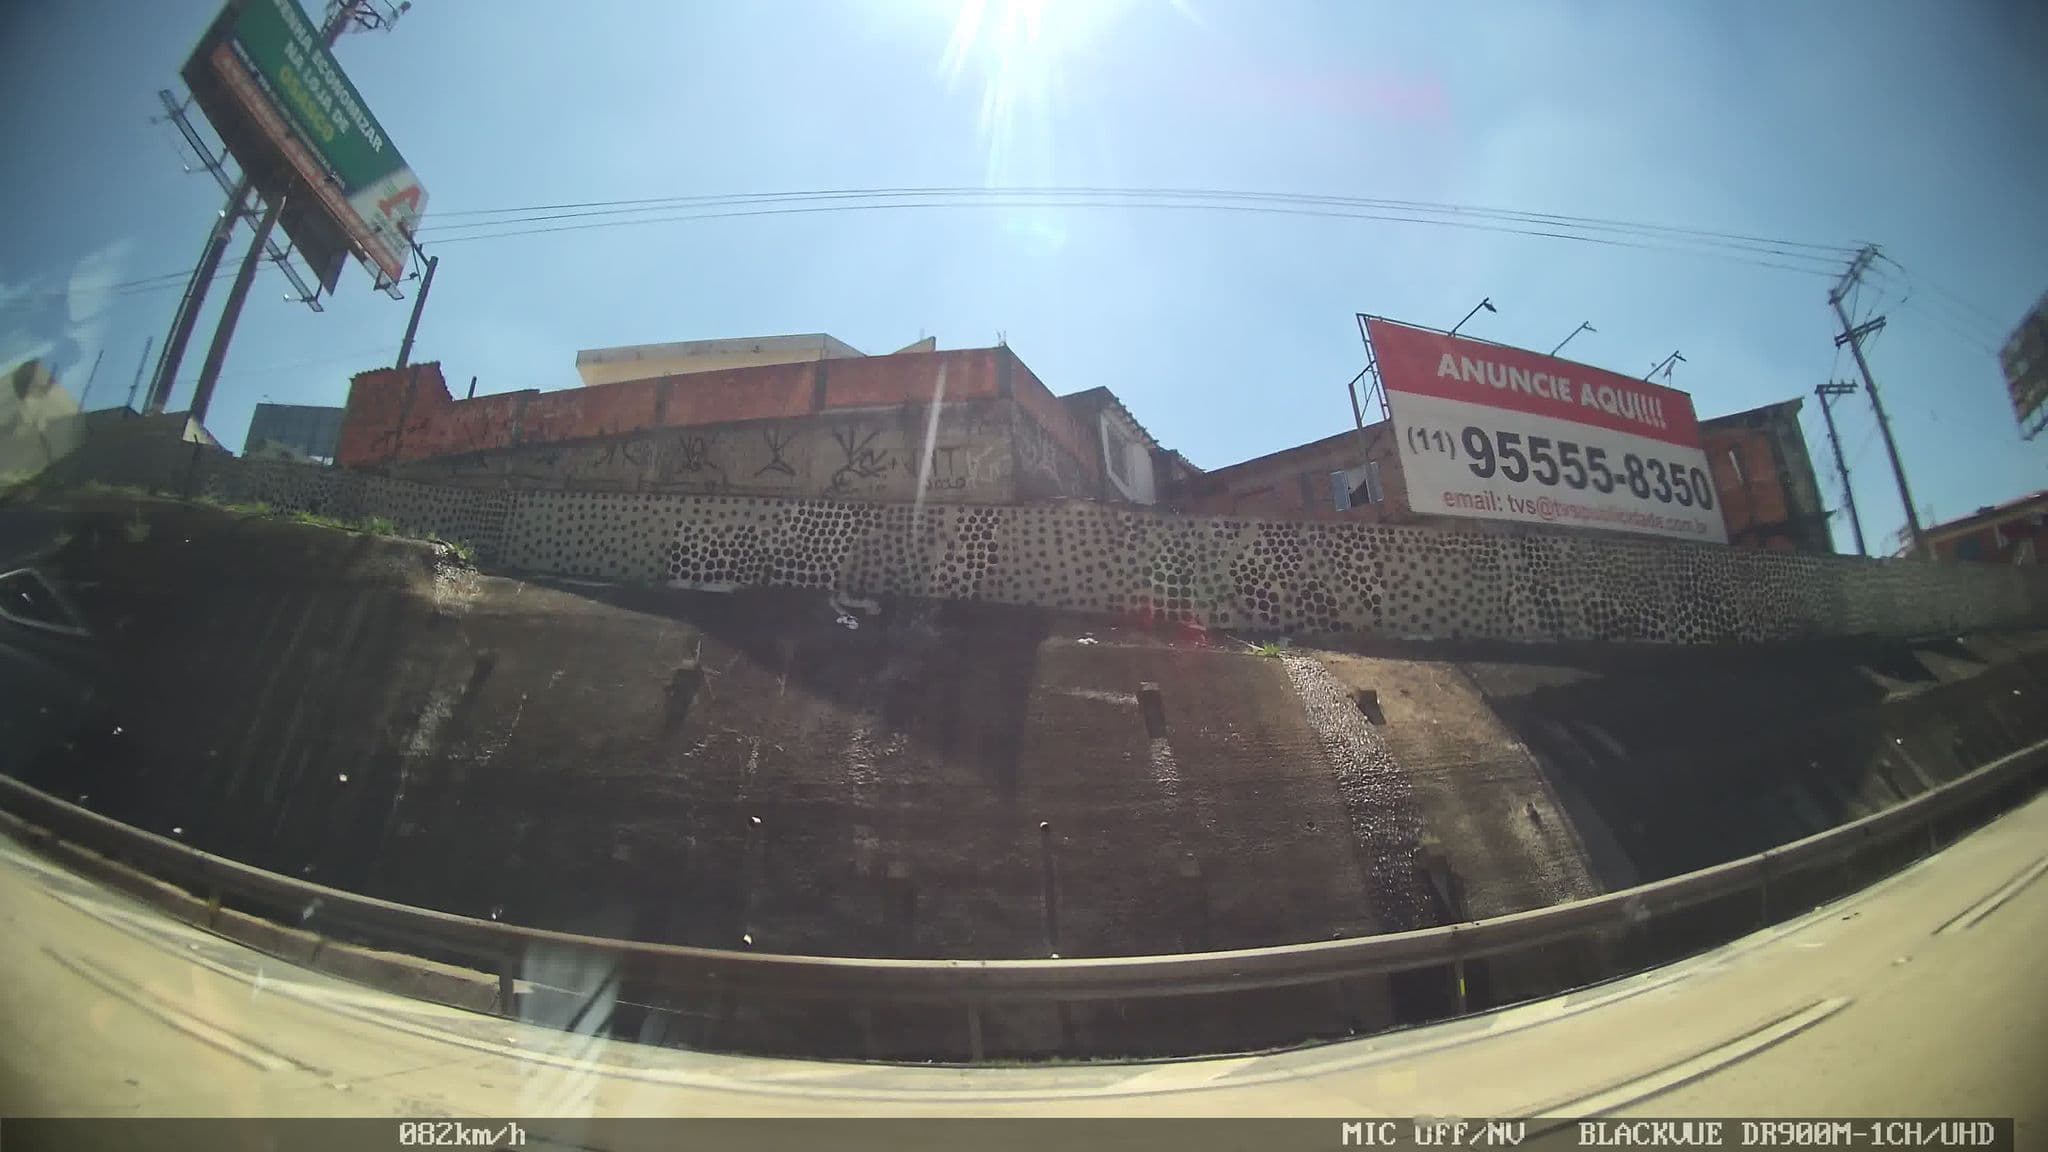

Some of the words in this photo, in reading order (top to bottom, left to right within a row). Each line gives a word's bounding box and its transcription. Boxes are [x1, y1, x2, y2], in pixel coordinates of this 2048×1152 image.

[1437, 353, 1574, 402] ANUNCIE
[1407, 425, 1456, 460] (11)
[1461, 425, 1714, 510] 95555-8350
[1443, 489, 1503, 512] email:
